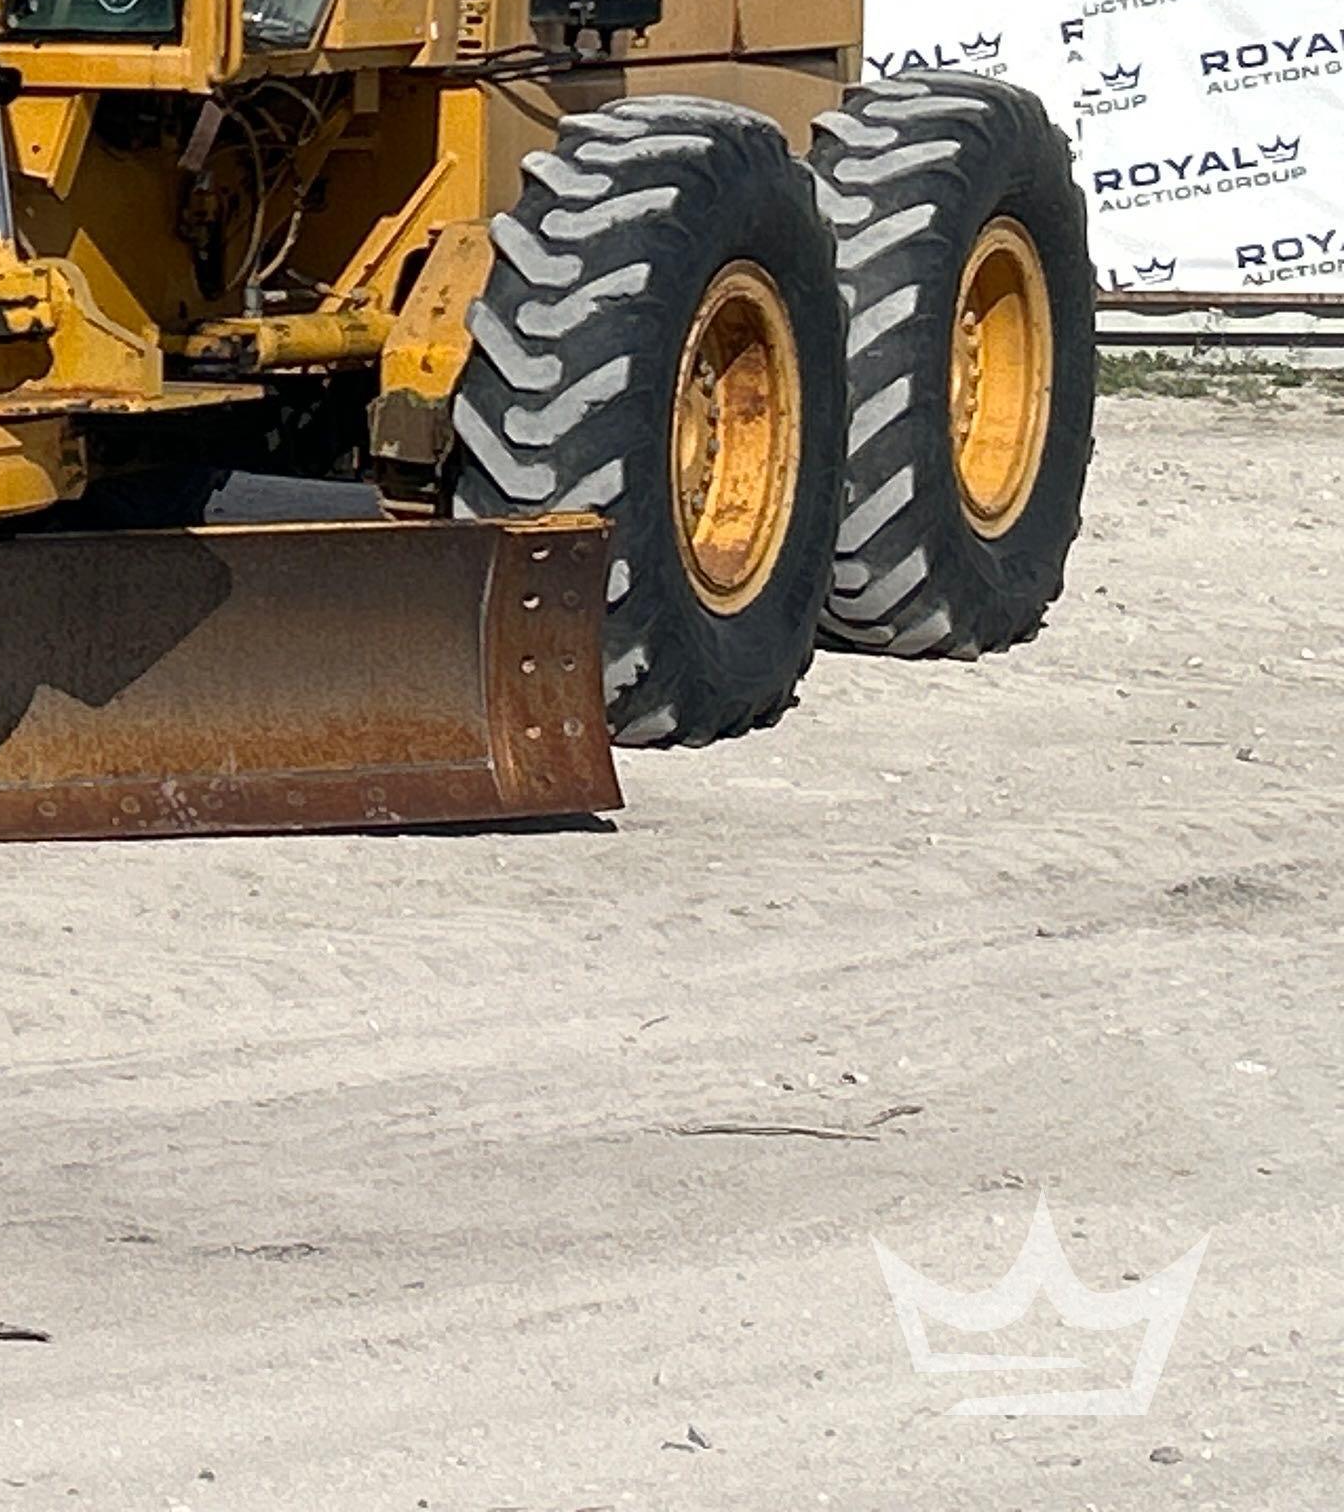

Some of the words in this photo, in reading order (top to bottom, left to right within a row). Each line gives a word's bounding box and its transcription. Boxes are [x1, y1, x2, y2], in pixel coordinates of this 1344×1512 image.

[1200, 29, 1344, 76] ROYA
[1206, 66, 1319, 95] AUCTION
[1093, 147, 1258, 194] ROYAL
[1099, 183, 1212, 213] AUCTION
[1217, 166, 1307, 193] GROUP
